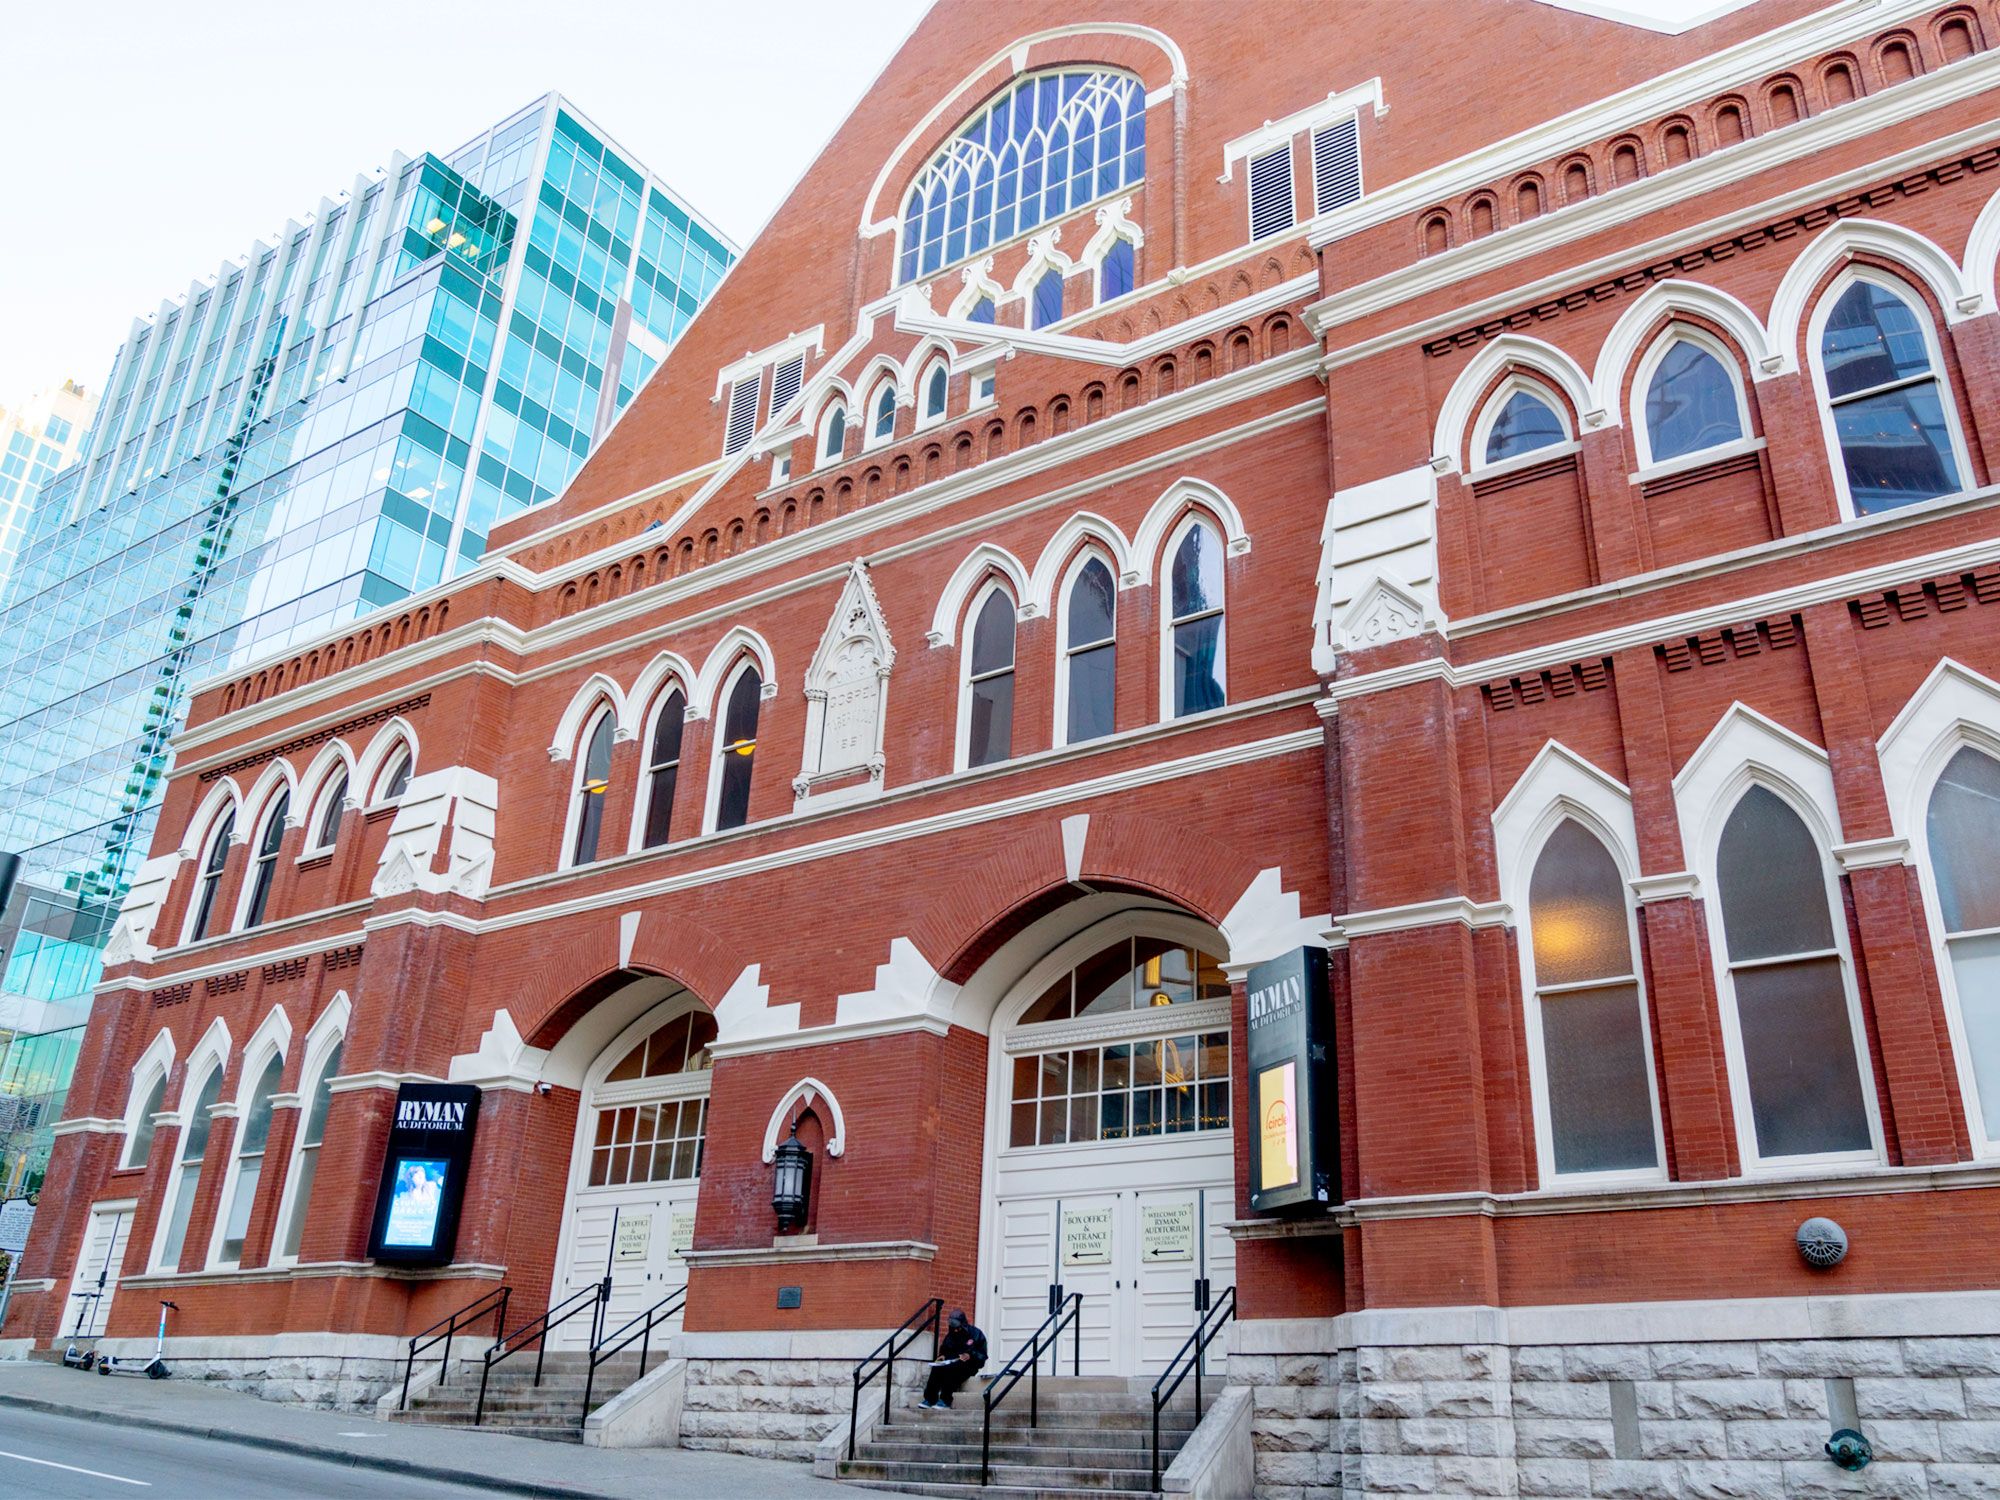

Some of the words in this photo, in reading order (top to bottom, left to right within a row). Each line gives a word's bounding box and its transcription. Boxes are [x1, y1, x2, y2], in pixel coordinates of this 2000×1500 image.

[830, 686, 877, 708] GOSPEL
[1249, 974, 1301, 1021] RYMAN
[397, 1100, 468, 1122] RYMAN
[1067, 1216, 1082, 1224] BOX
[1083, 1214, 1107, 1223] OFFICE
[1145, 1225, 1191, 1234] AUDITORIUM
[1067, 1232, 1107, 1241] ENTRANCE
[1072, 1242, 1087, 1250] THIS
[1088, 1241, 1102, 1249] WAY
